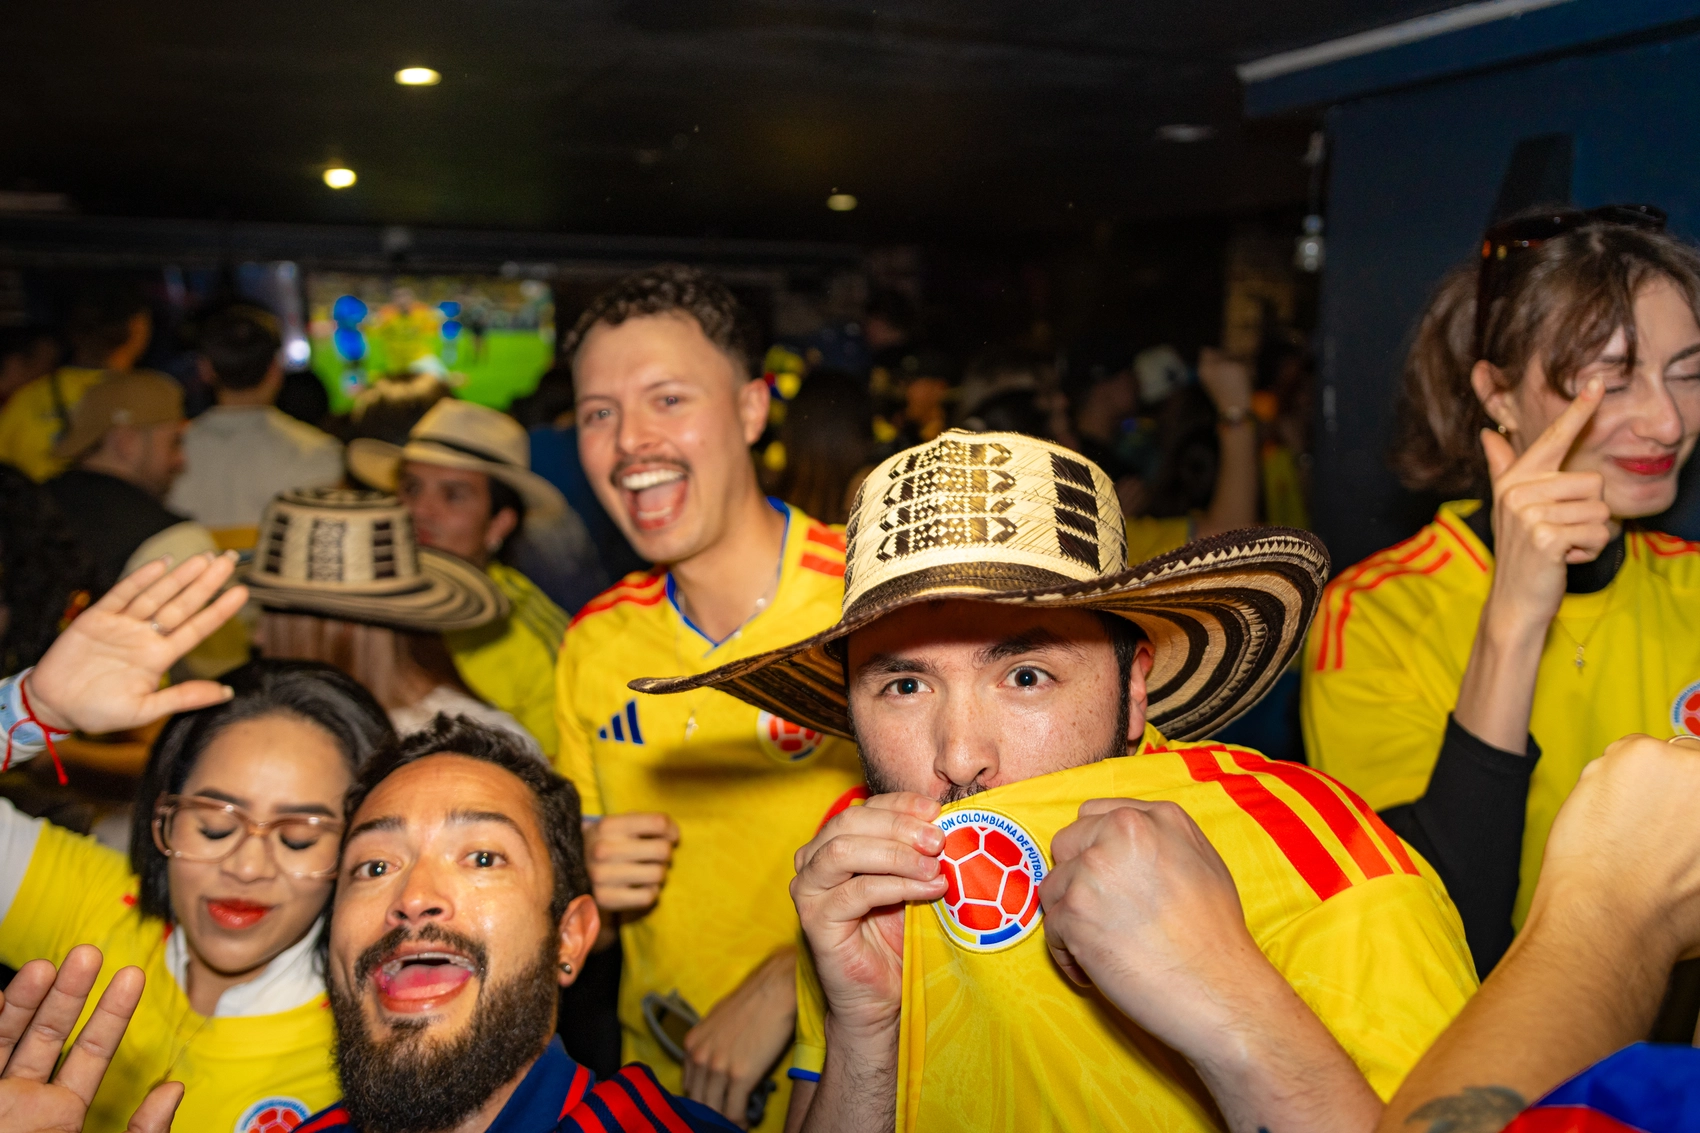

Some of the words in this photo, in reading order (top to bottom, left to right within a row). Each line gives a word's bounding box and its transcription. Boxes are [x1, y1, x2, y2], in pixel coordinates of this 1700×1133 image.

[956, 812, 1018, 838] COLOMBIANA
[1016, 834, 1030, 848] DE
[1025, 846, 1043, 882] FÚTBOL
